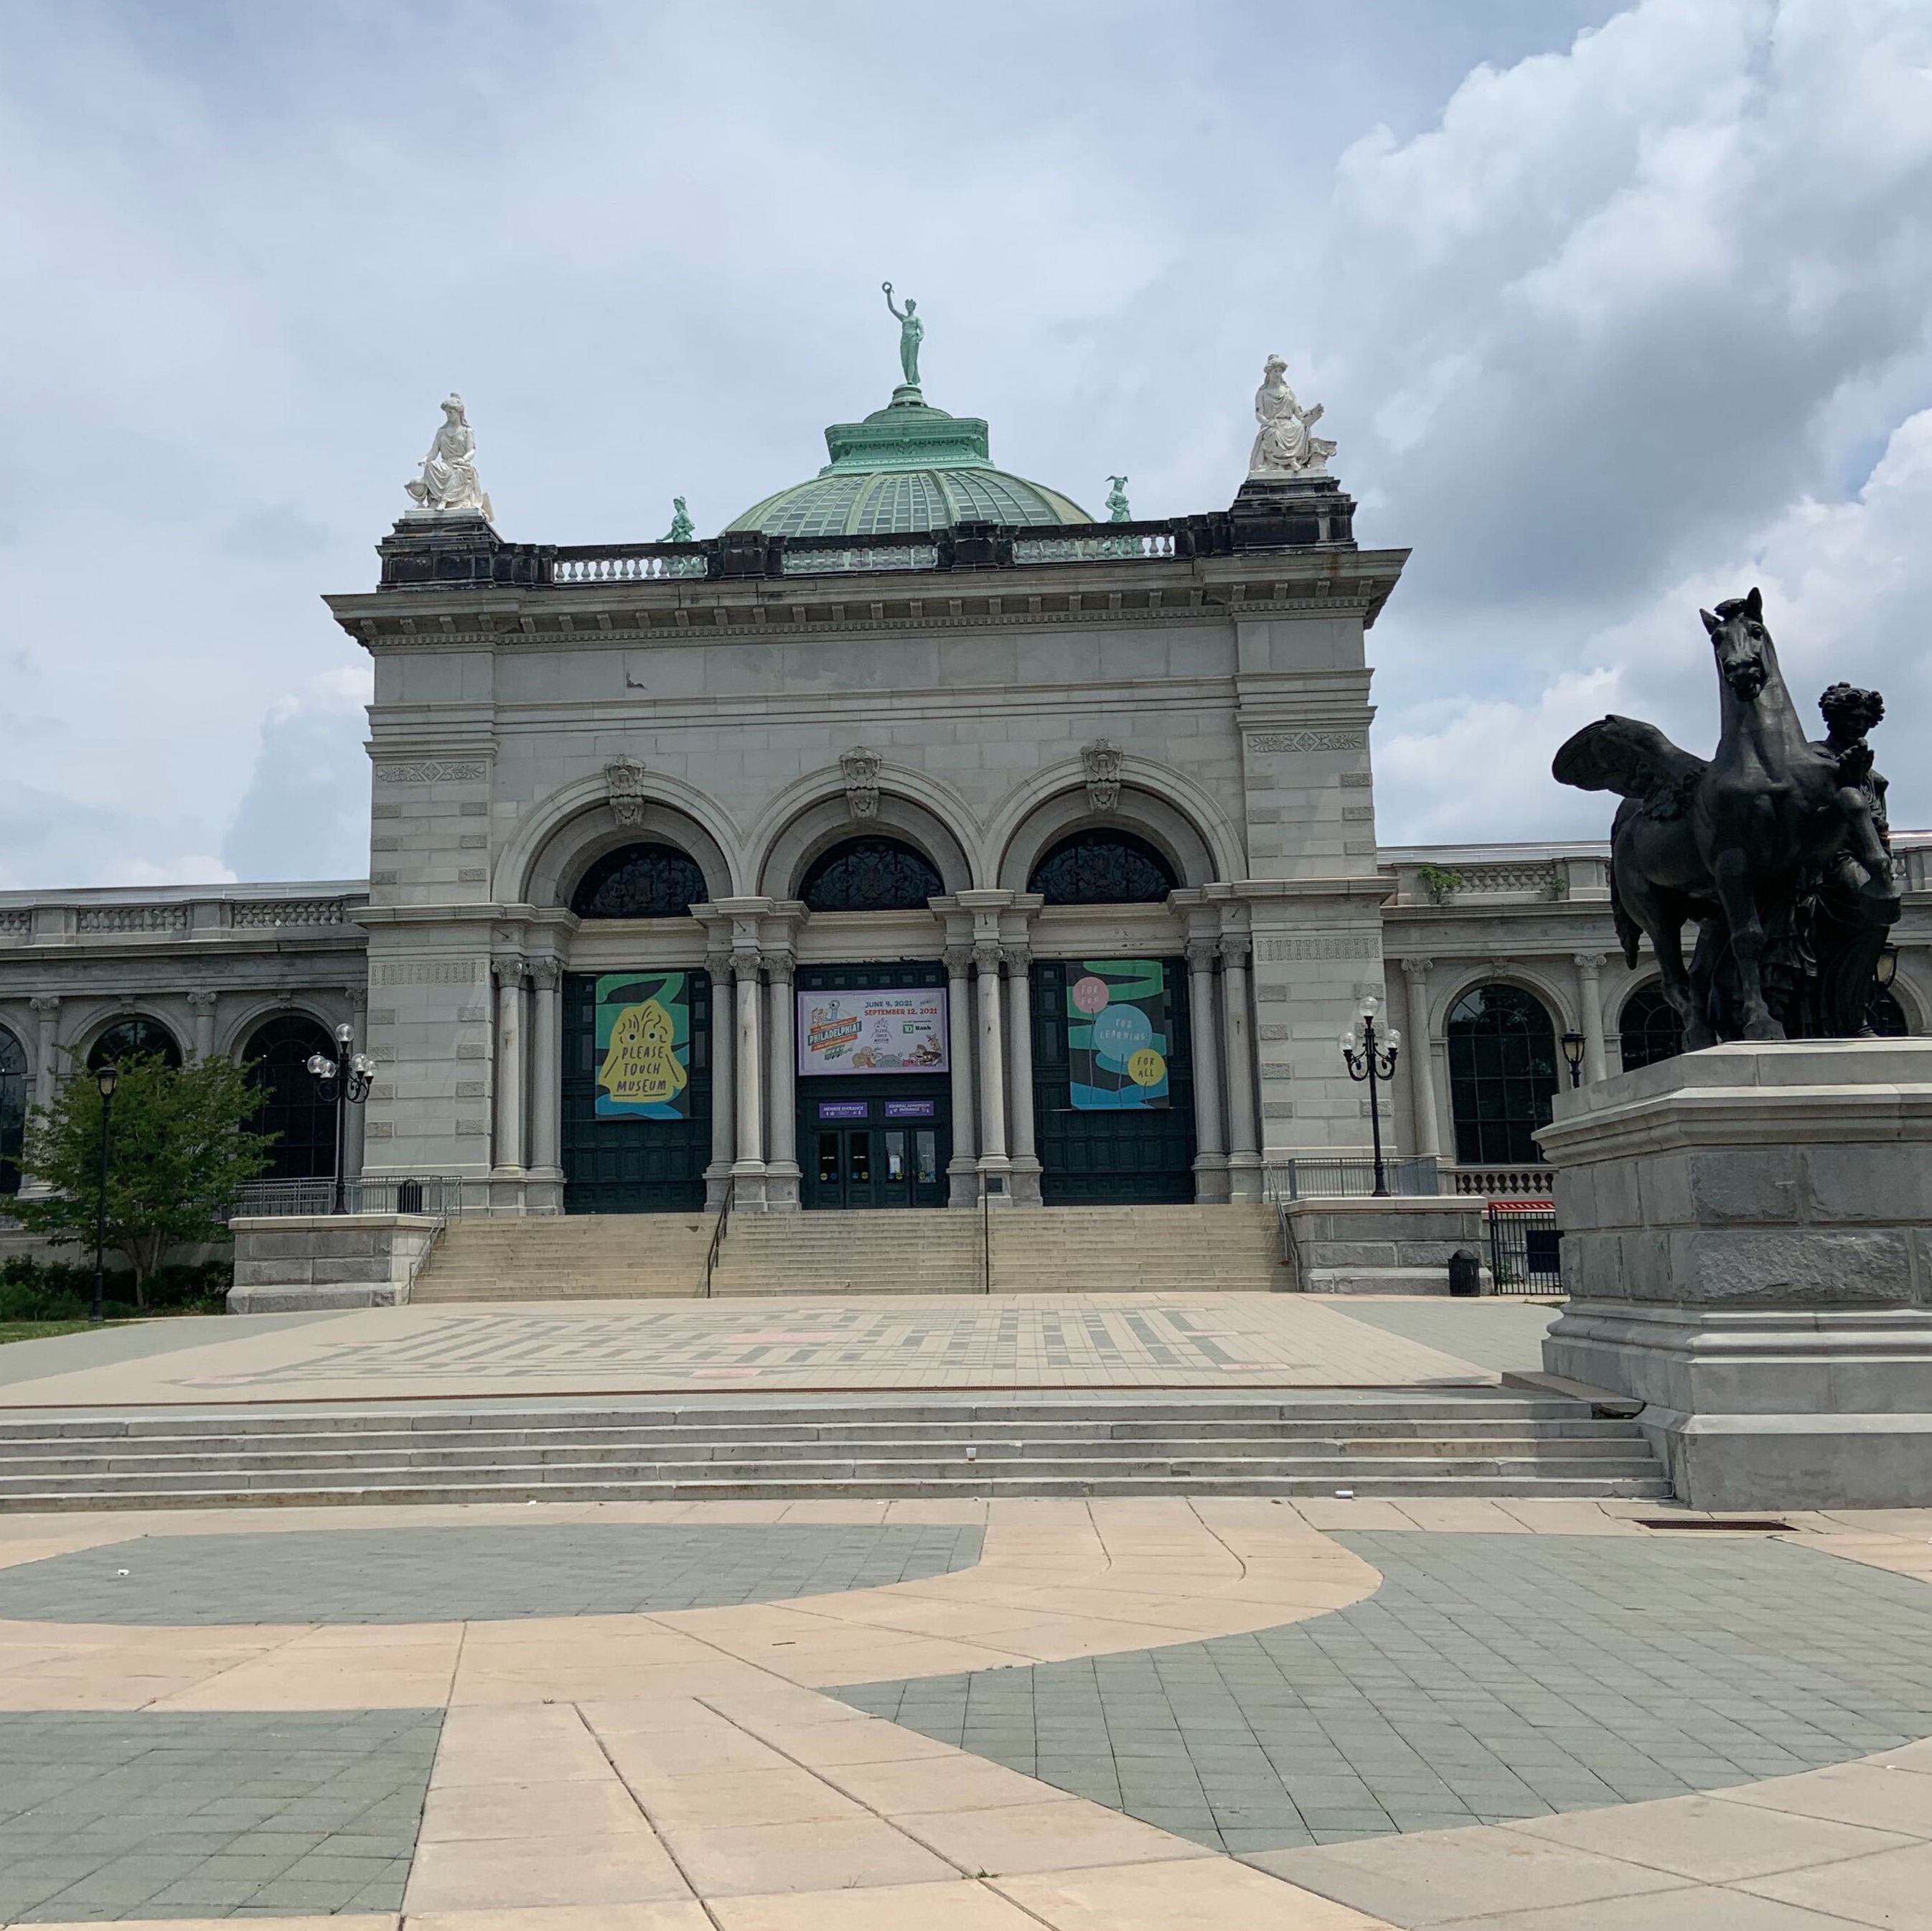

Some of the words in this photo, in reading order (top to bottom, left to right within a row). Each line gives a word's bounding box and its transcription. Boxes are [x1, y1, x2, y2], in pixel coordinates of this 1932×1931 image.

[1081, 985, 1098, 995] FOR
[1082, 996, 1099, 1005] FUN
[1115, 1019, 1133, 1028] FOR
[809, 1022, 860, 1044] PHILADELPHIA!
[1099, 1029, 1146, 1042] LEARNING
[622, 1046, 665, 1060] PLEASE
[1138, 1057, 1155, 1066] FOR
[624, 1063, 660, 1076] TOUCH
[1138, 1068, 1154, 1077] ALL
[616, 1079, 667, 1093] MUSEUM
